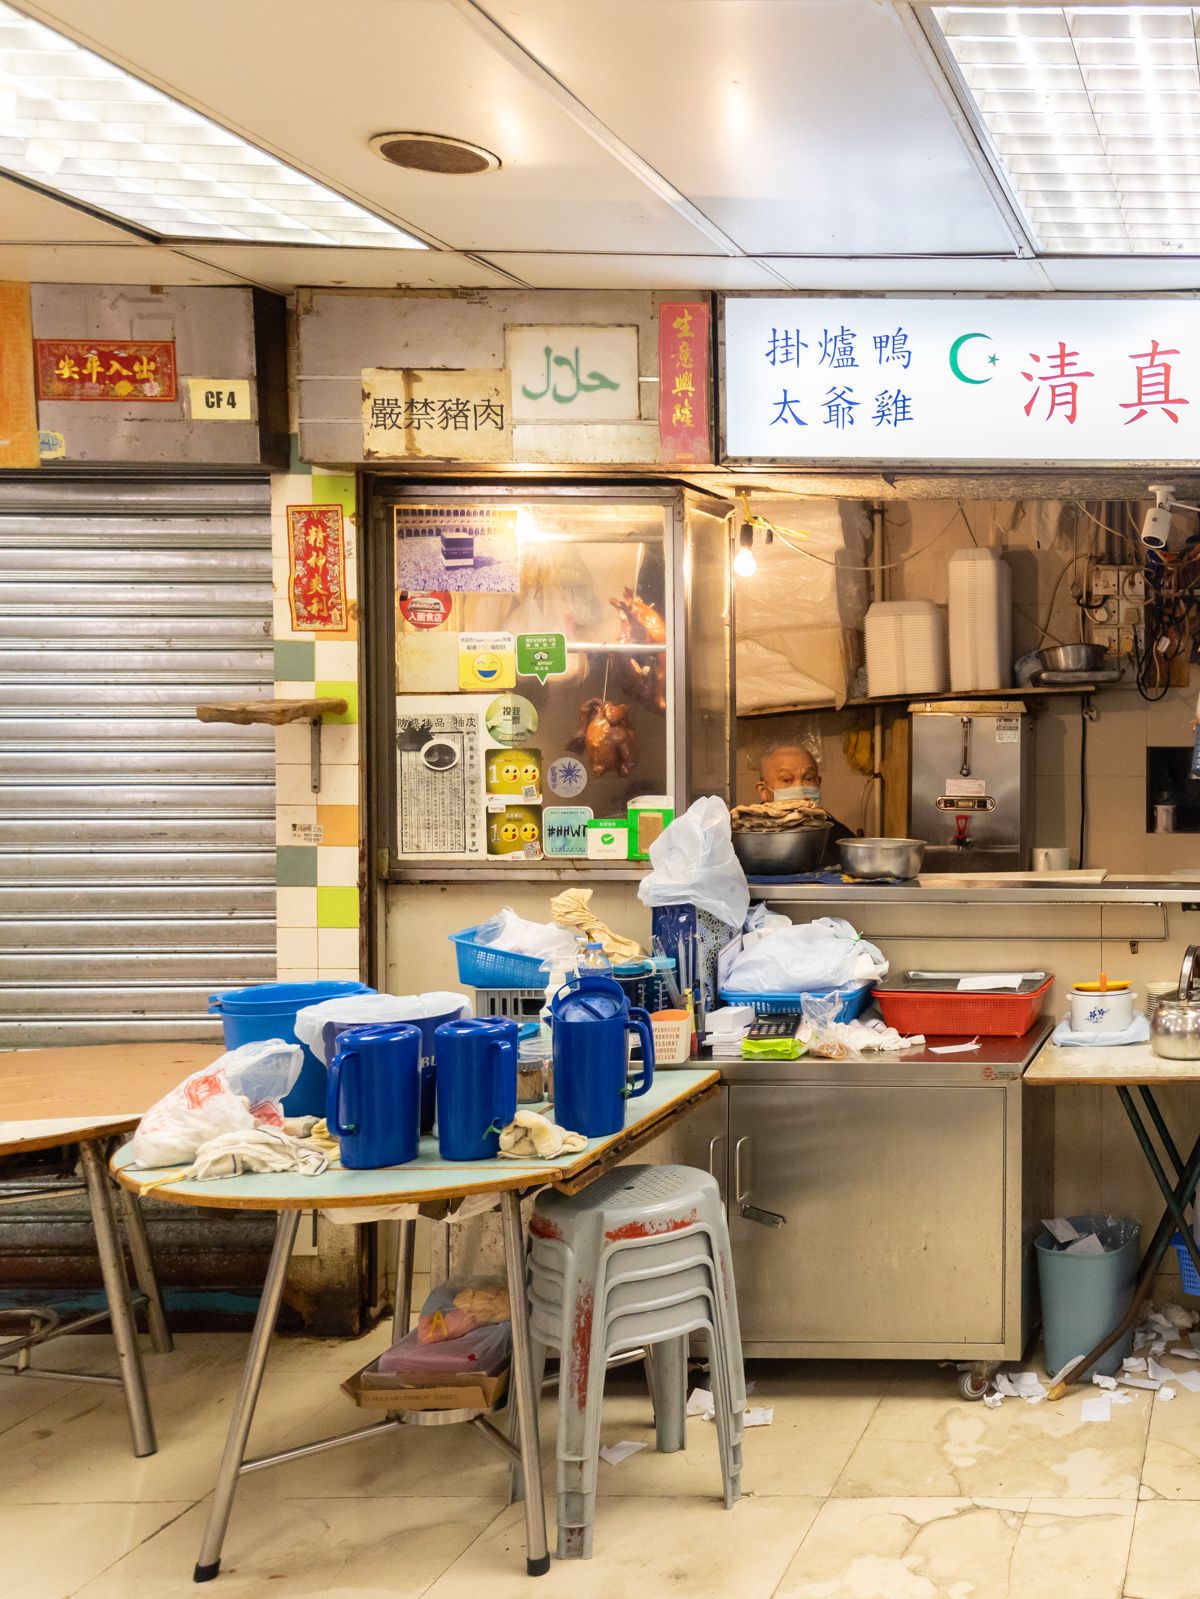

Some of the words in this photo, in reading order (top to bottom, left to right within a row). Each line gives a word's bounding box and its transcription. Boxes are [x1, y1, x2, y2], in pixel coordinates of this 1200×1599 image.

[765, 325, 913, 369] 掛爐鴨
[522, 346, 620, 404] حلال
[205, 391, 223, 409] CF
[226, 391, 237, 408] 4
[370, 398, 504, 431] 嚴禁豬肉
[769, 386, 914, 430] 太爺雞
